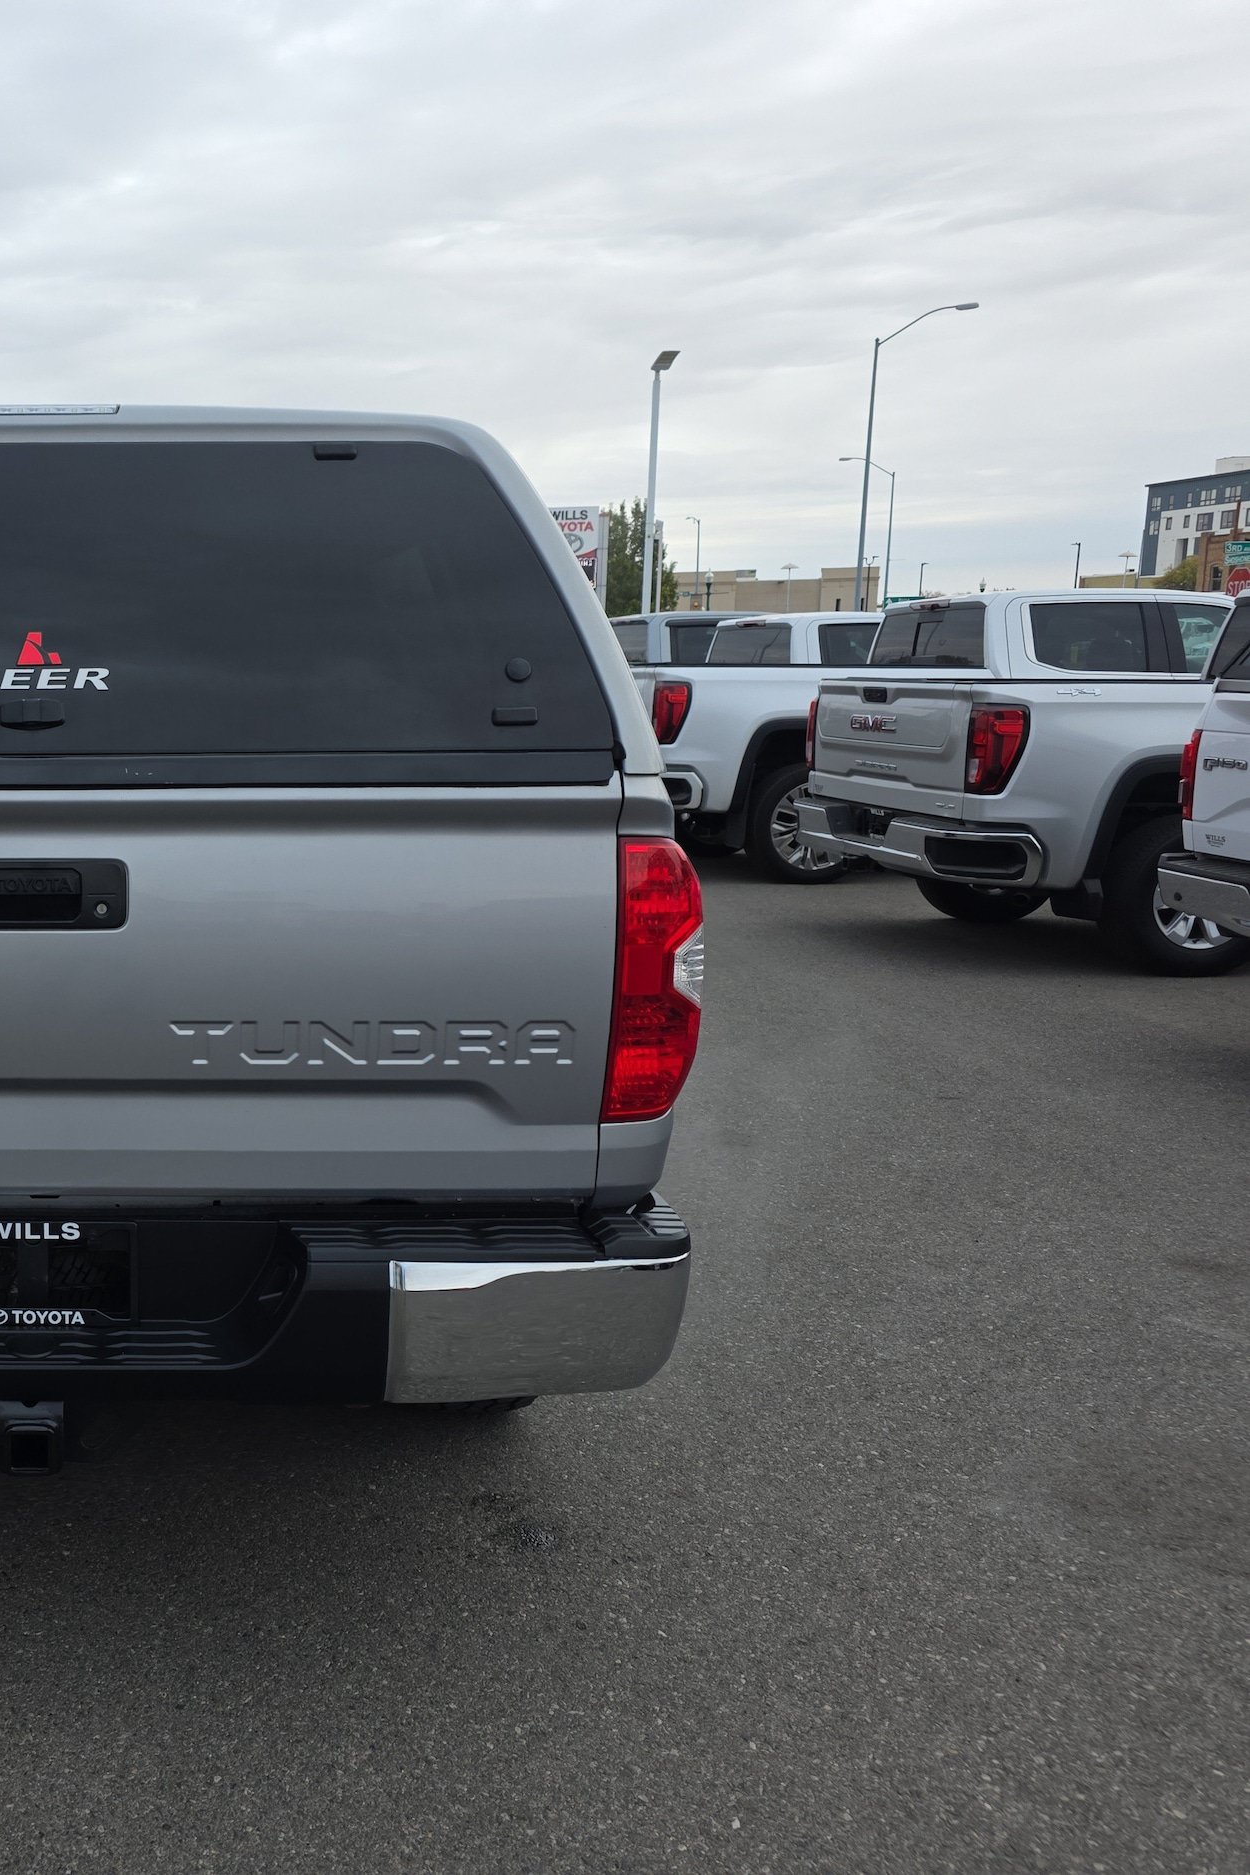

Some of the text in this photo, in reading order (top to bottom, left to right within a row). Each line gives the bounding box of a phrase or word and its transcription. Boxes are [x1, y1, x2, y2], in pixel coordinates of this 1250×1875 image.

[551, 510, 588, 520] WILLS
[559, 521, 594, 532] YOTA
[851, 714, 897, 733] GMC
[1206, 833, 1226, 842] WILLS
[170, 1020, 576, 1065] TUNDRA
[11, 1310, 86, 1325] TOYOTA
